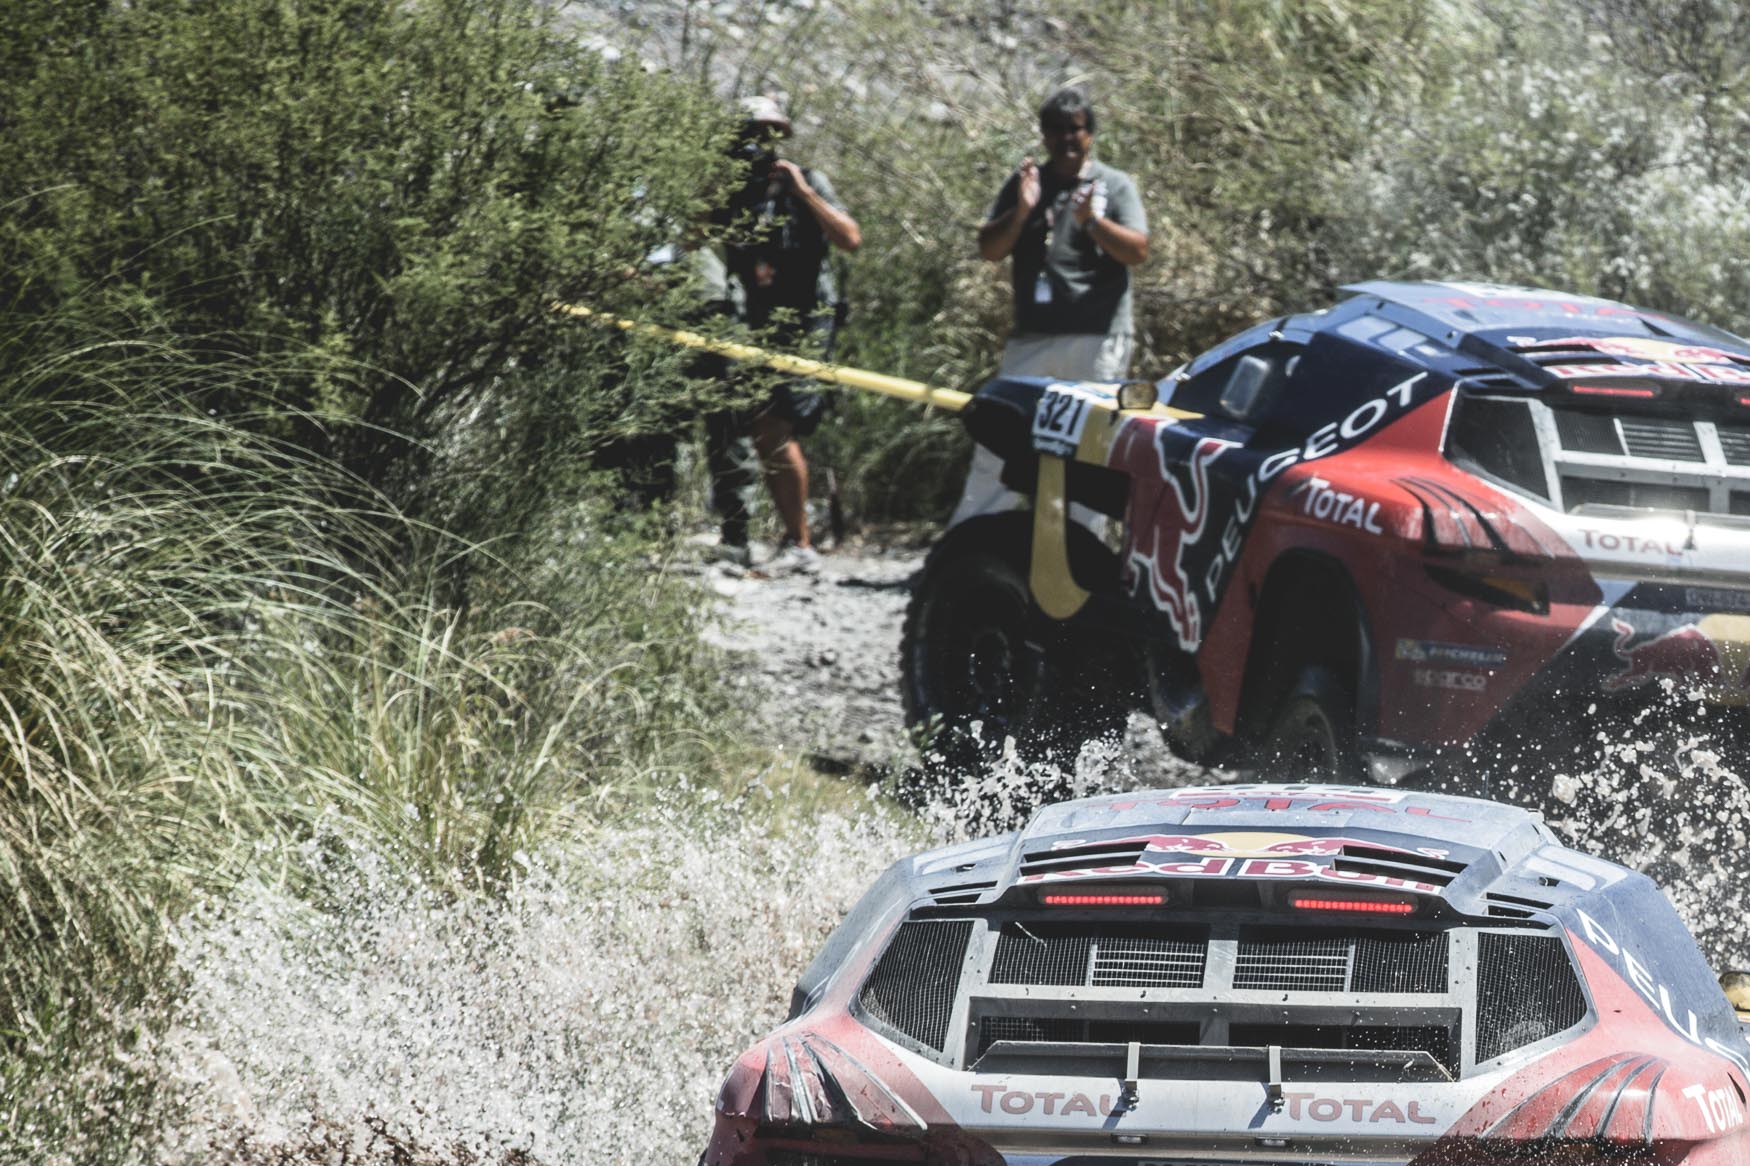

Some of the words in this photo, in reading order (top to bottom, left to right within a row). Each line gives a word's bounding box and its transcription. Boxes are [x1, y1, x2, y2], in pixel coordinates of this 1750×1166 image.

[1039, 391, 1086, 437] 321
[1206, 371, 1429, 604] PEUGEOT
[1304, 477, 1383, 536] TOTAL
[1578, 528, 1684, 556] TOTAL
[1281, 1092, 1437, 1125] TOTAL
[1682, 1083, 1744, 1134] TOTAL
